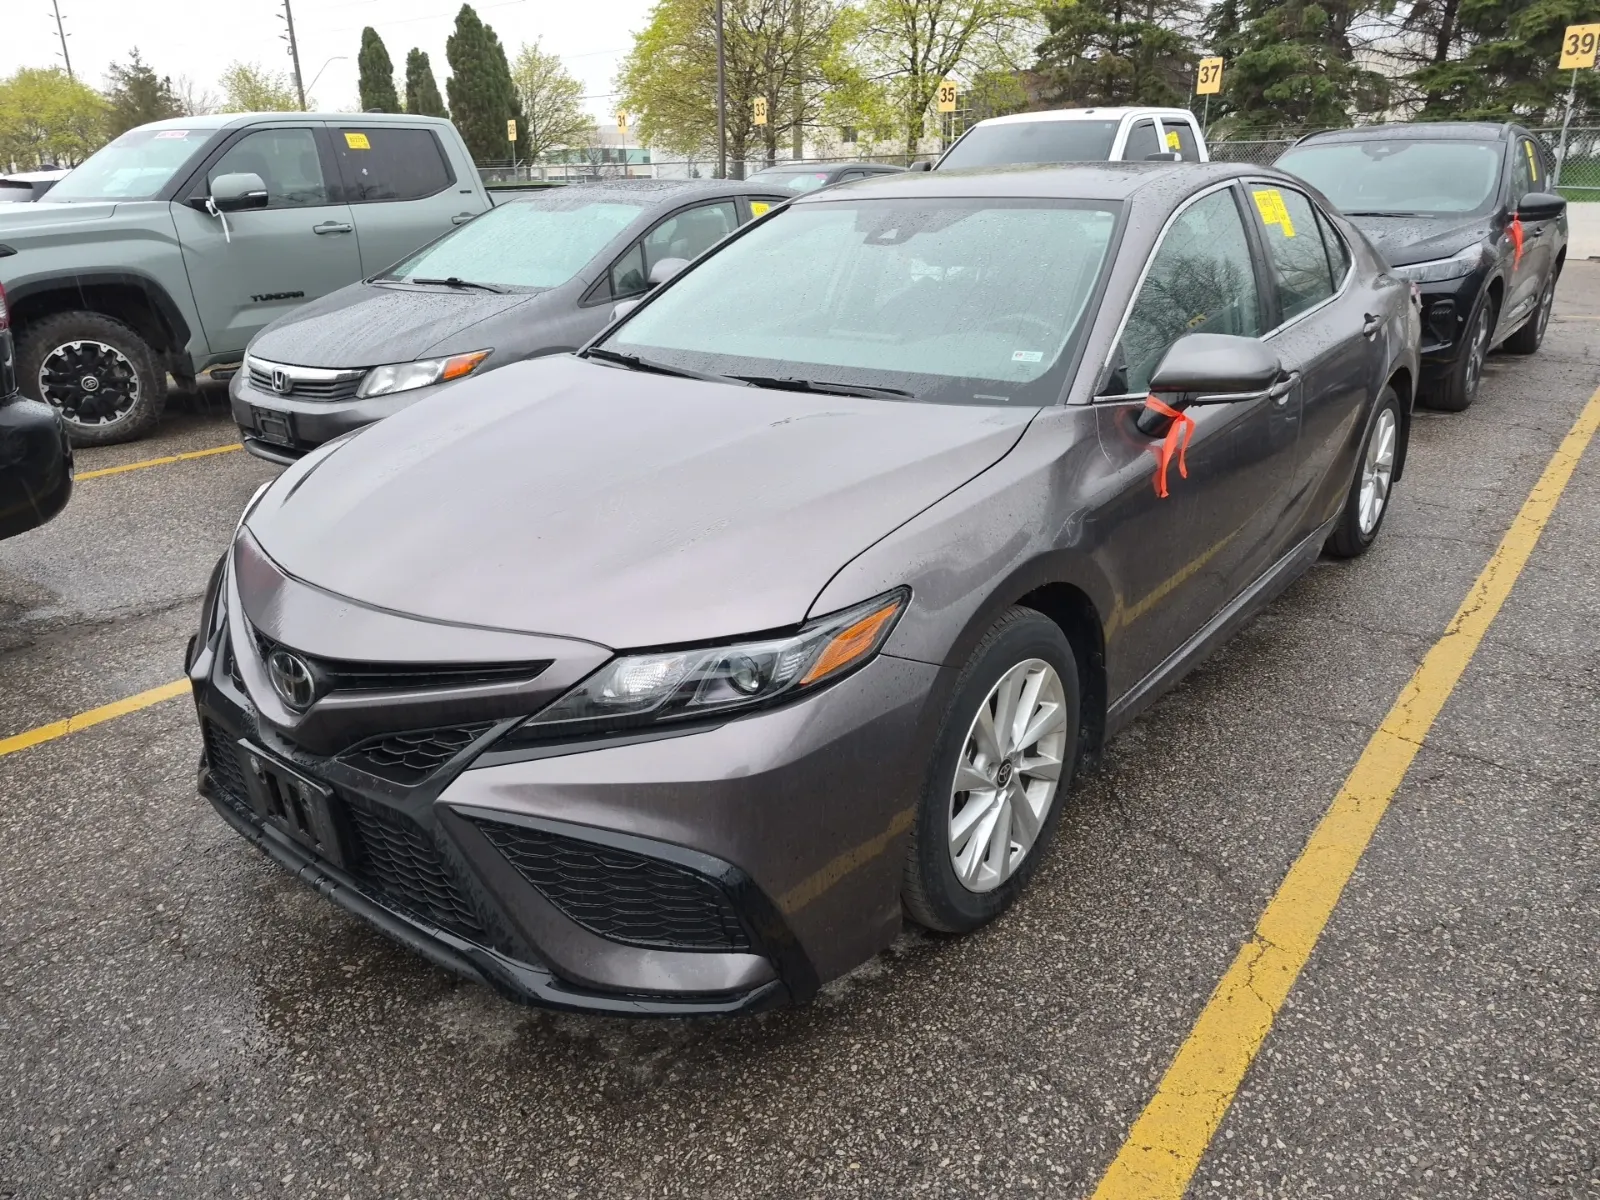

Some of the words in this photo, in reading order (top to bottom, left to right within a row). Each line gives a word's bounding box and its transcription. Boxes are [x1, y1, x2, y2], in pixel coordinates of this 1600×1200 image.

[1565, 33, 1595, 56] 39
[1200, 65, 1220, 84] 37
[940, 87, 955, 103] 35
[756, 103, 765, 116] 33
[618, 115, 626, 127] 31
